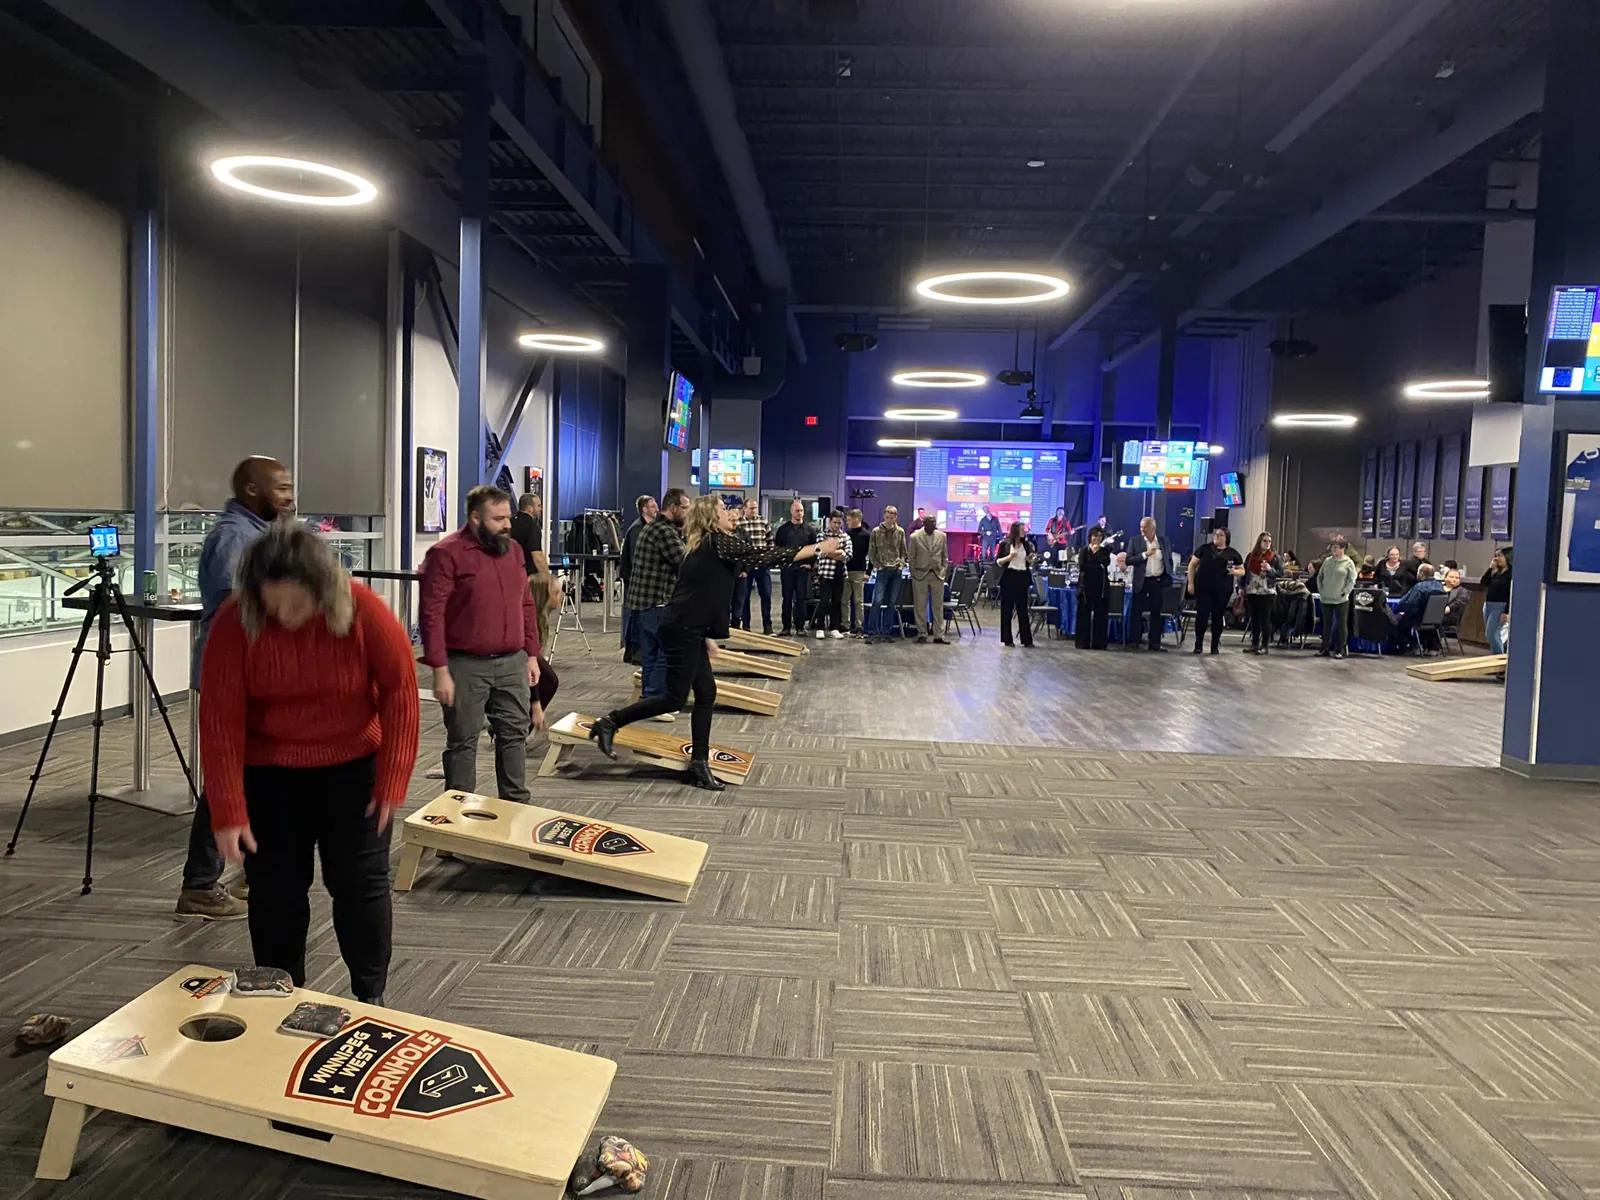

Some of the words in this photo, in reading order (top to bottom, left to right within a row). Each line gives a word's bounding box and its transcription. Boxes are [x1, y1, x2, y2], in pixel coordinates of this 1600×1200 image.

[425, 476, 436, 499] 97
[308, 1030, 372, 1085] WINNIPEG
[338, 1044, 378, 1078] WEST
[359, 1031, 442, 1114] CORNHOLE
